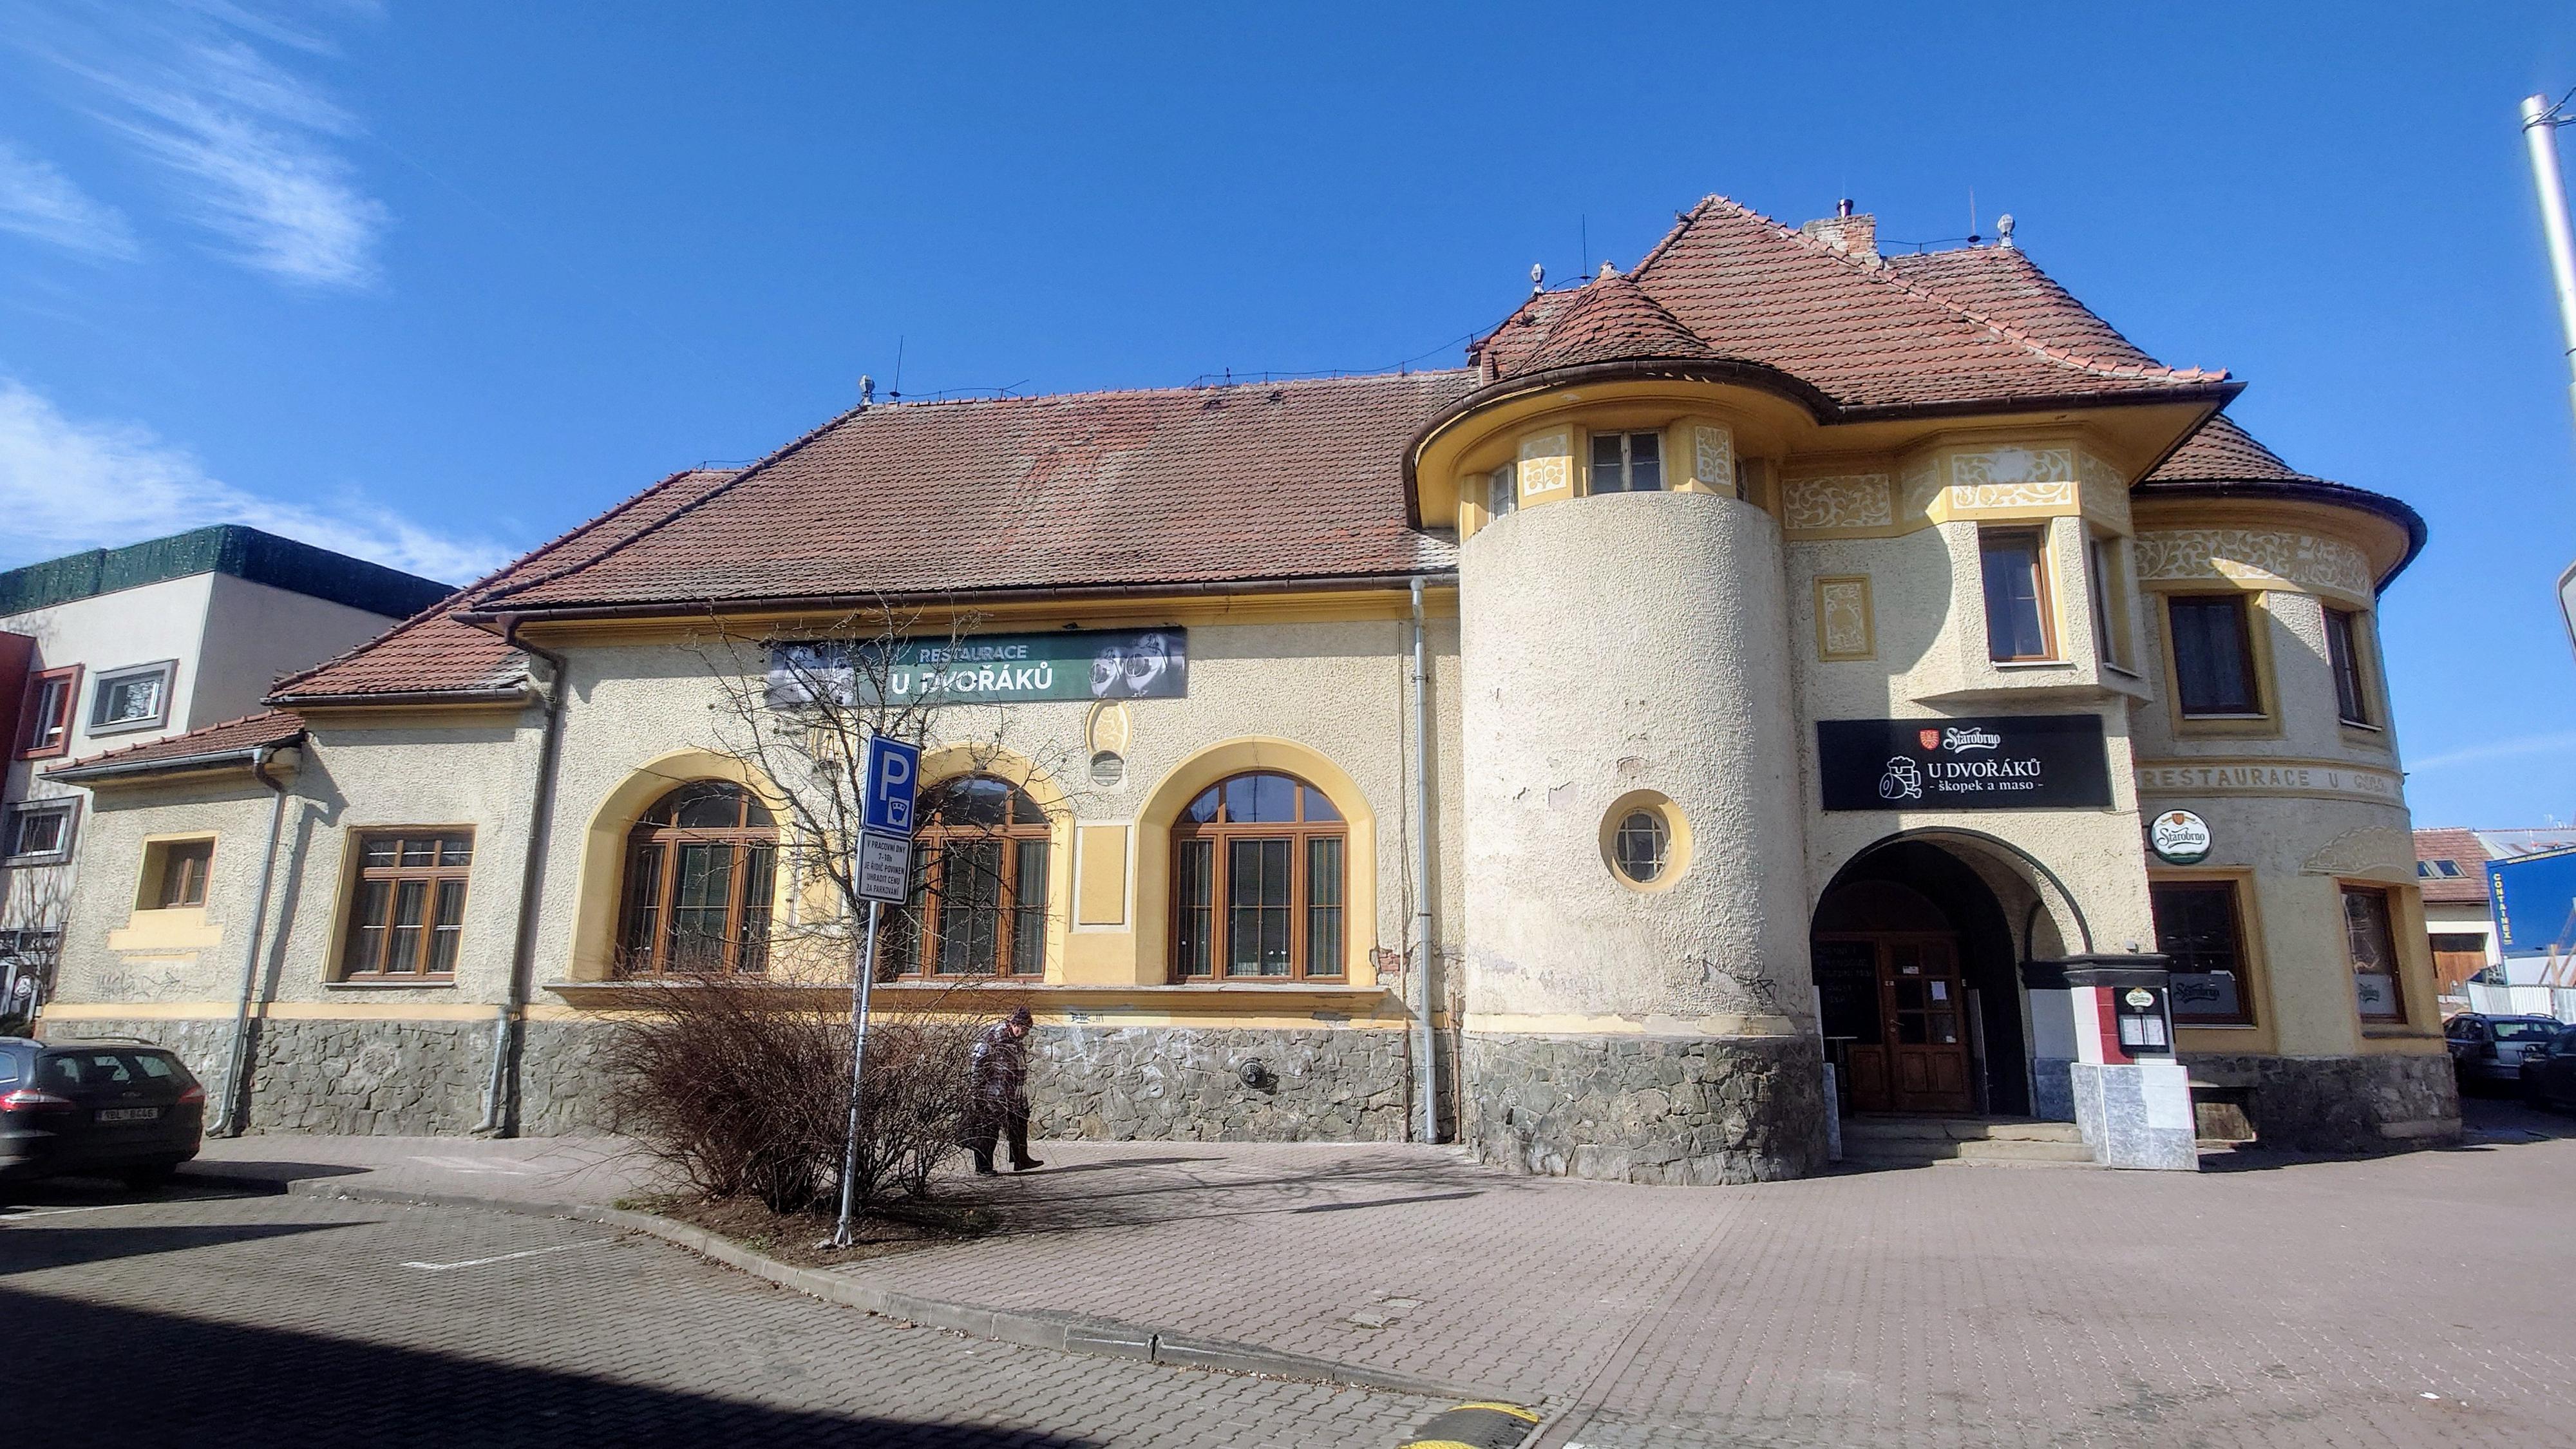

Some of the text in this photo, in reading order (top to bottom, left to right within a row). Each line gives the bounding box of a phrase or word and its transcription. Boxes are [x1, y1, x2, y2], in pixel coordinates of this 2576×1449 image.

[920, 645, 1027, 663] RESTAURACE
[891, 661, 1053, 695] U DVOŘÁKŮ
[1943, 727, 2001, 752] Starobrno
[880, 750, 909, 801] P
[1927, 758, 2041, 778] U DVOŘÁKŮ
[1938, 780, 1984, 793] škopek
[2000, 781, 2034, 790] maso
[2141, 768, 2310, 788] RESTAURACE
[2327, 772, 2339, 789] U
[871, 840, 895, 852] PRACOVNÍ
[2157, 828, 2206, 849] Starobrno
[870, 861, 884, 872] ŘIDIČ
[884, 864, 905, 875] POVINEN
[867, 873, 900, 885] UHRADIT CENU
[873, 886, 900, 896] PARKOVÁNÍ
